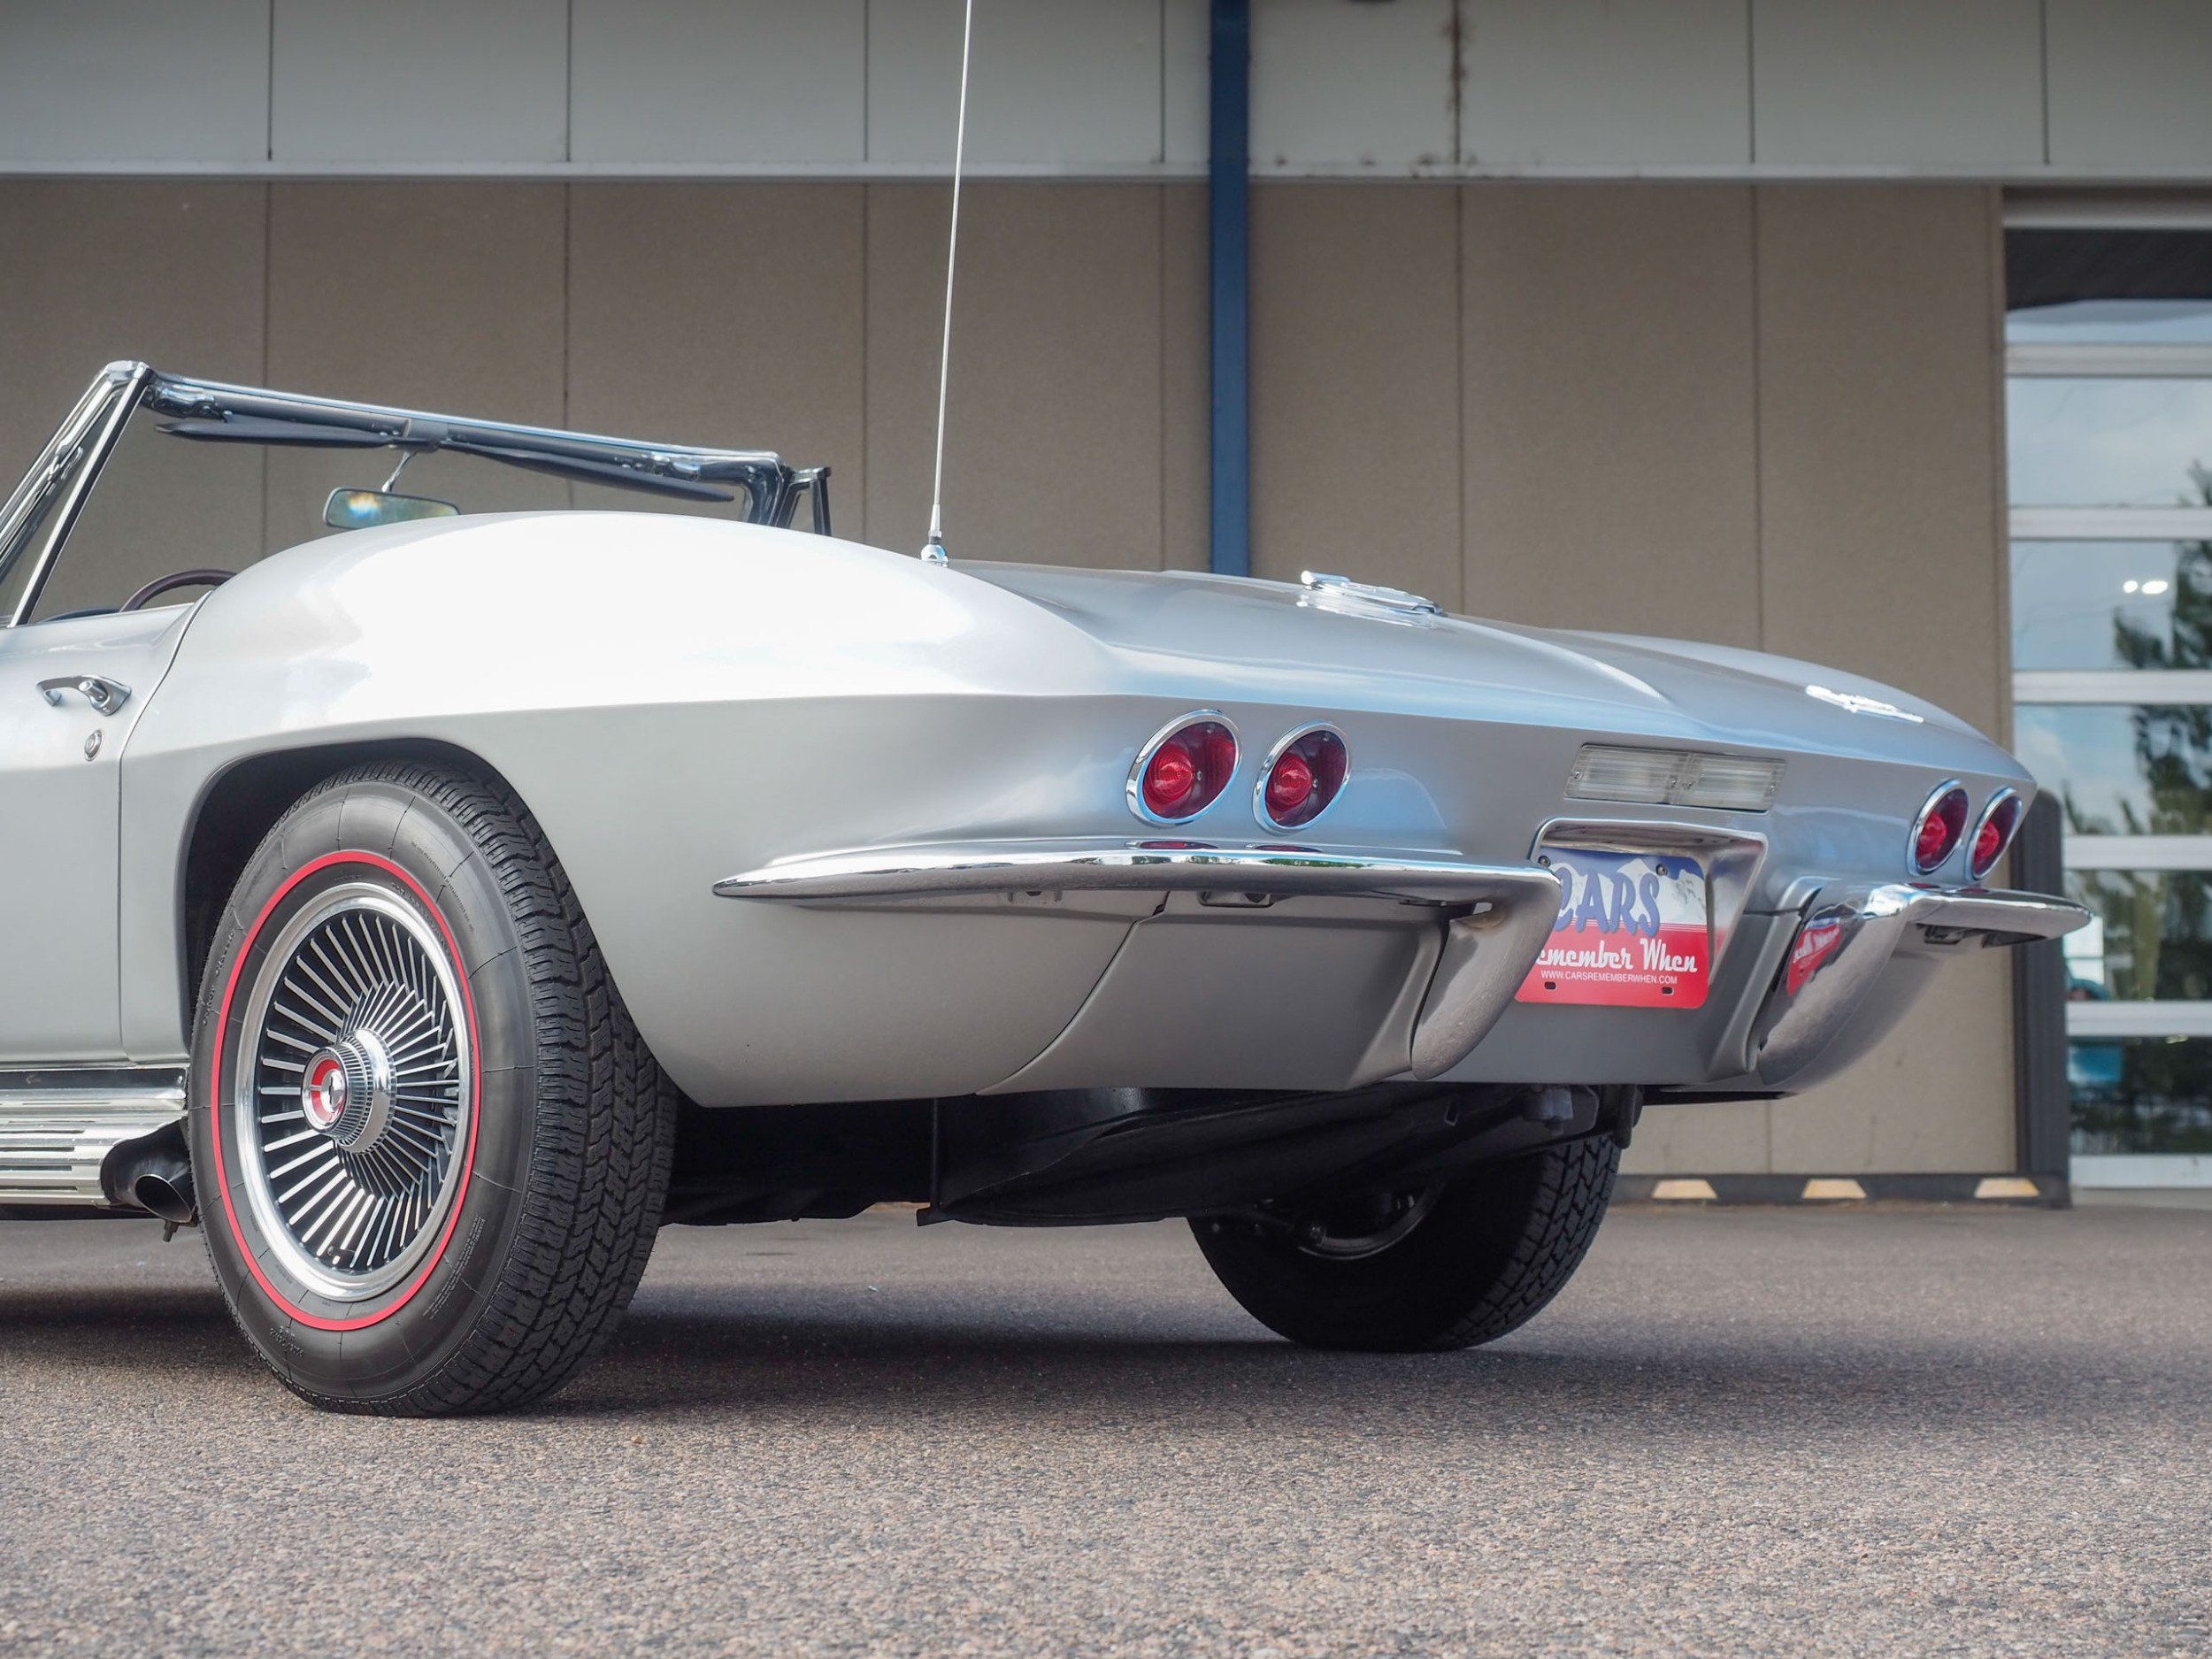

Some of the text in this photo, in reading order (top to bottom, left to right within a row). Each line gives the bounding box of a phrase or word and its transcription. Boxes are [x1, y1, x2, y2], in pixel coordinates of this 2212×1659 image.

[1536, 938, 1698, 972] emember When
[1540, 970, 1678, 985] WWW.CARSREMEMBERWHEN.COM
